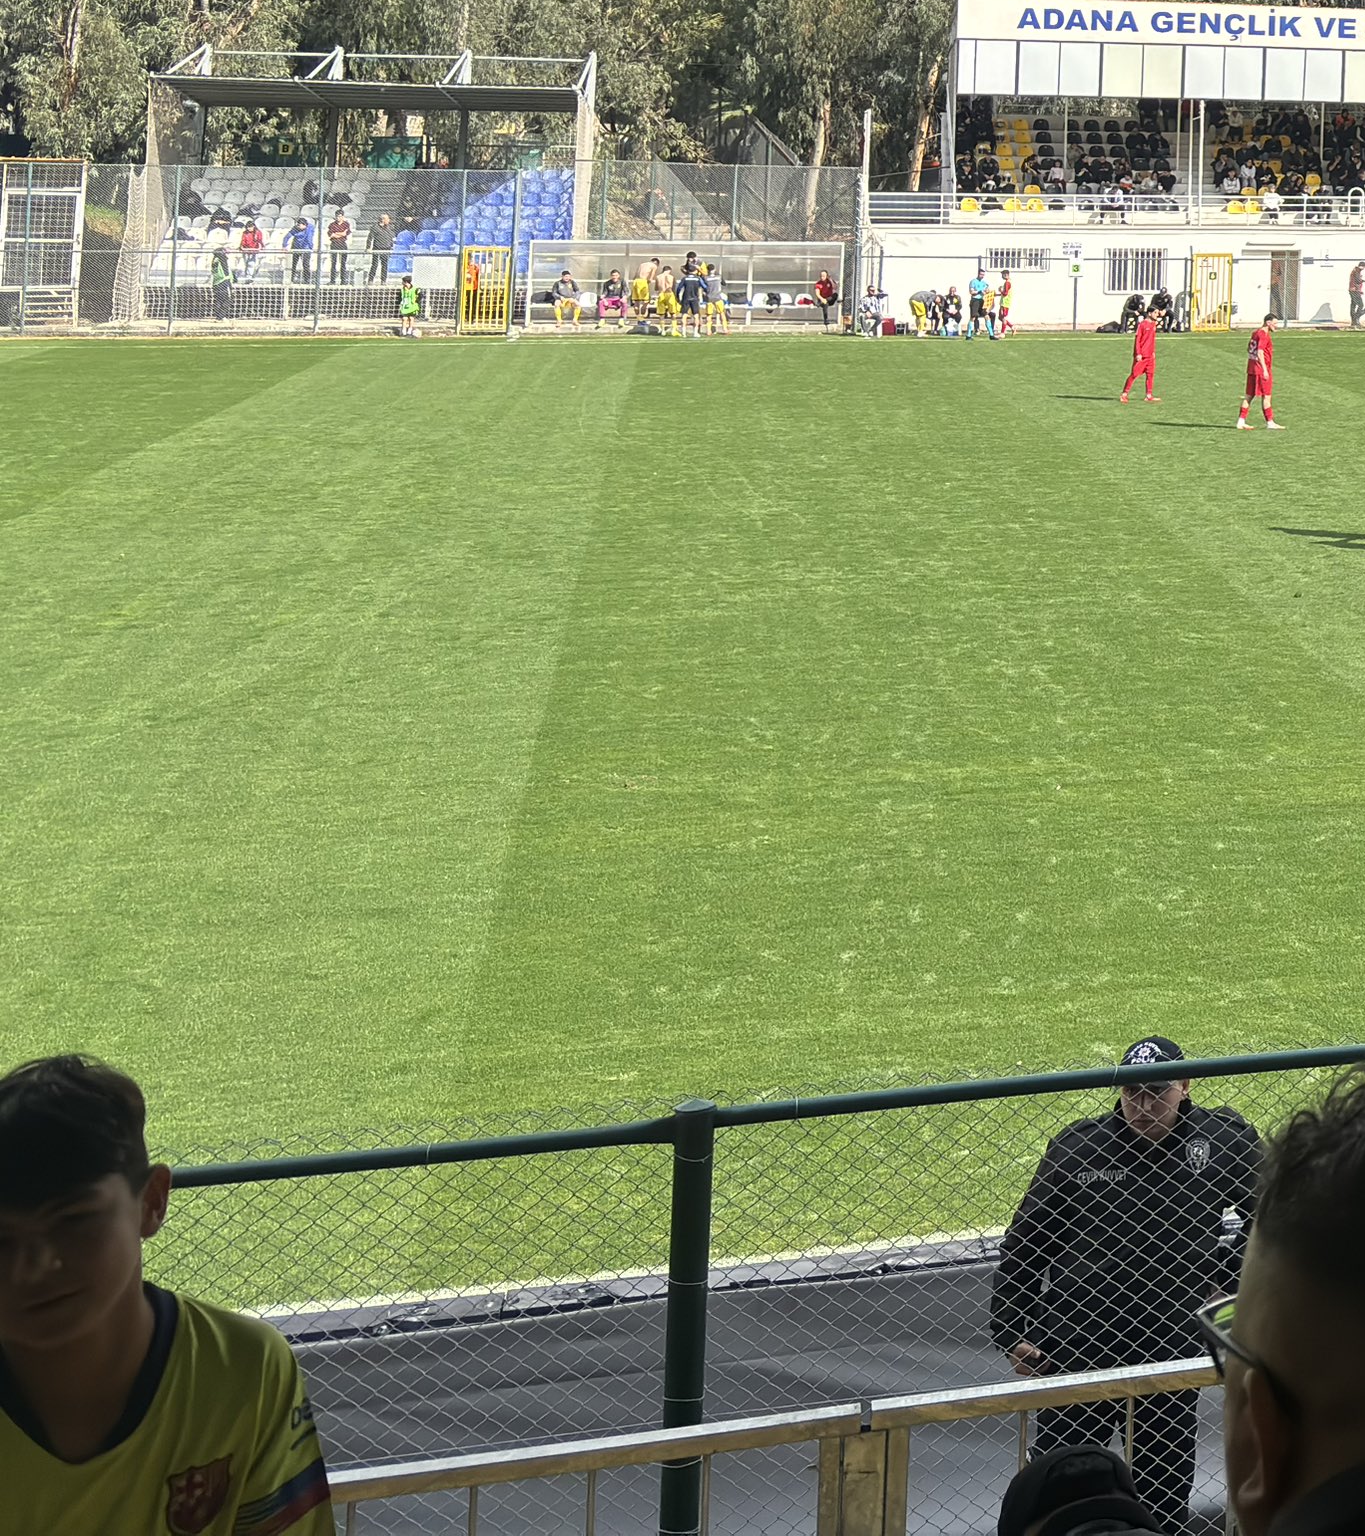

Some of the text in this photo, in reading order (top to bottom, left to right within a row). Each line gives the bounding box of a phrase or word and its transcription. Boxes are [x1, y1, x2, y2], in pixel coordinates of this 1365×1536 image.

[1017, 8, 1139, 32] ADANA
[1150, 9, 1302, 41] GENÇLİK
[1314, 17, 1356, 38] VE
[1072, 264, 1080, 272] 3
